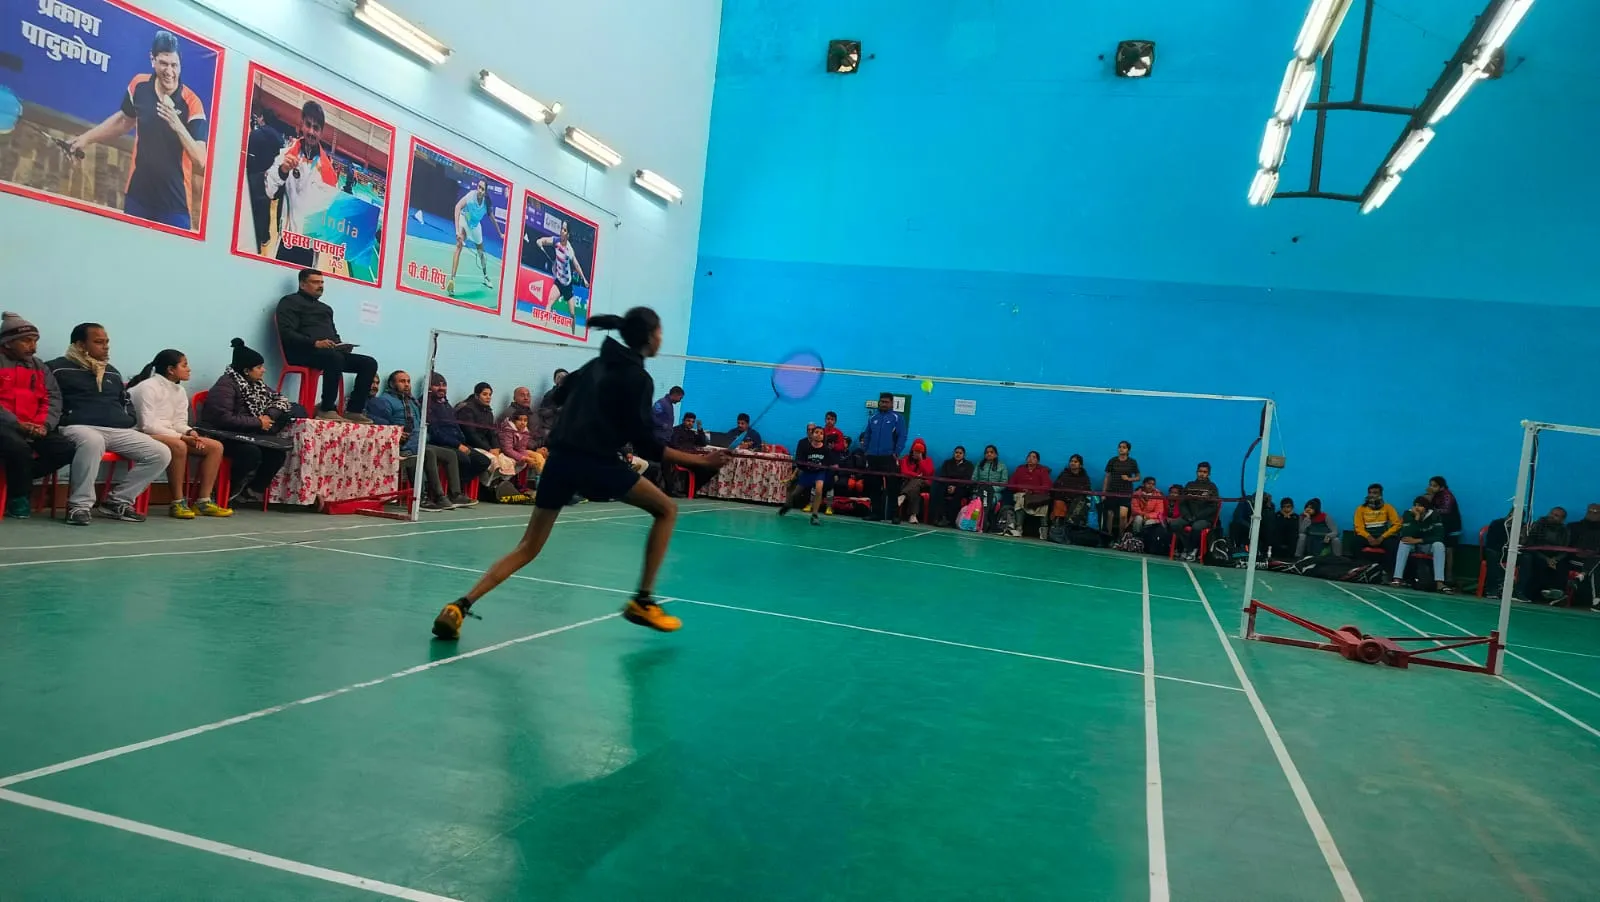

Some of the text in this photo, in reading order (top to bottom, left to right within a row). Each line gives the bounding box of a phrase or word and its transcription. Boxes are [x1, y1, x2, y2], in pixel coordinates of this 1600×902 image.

[21, 20, 111, 72] पादुकोण
[321, 212, 358, 238] India
[282, 230, 347, 259] सुहास एलवाई
[329, 259, 343, 269] IAS
